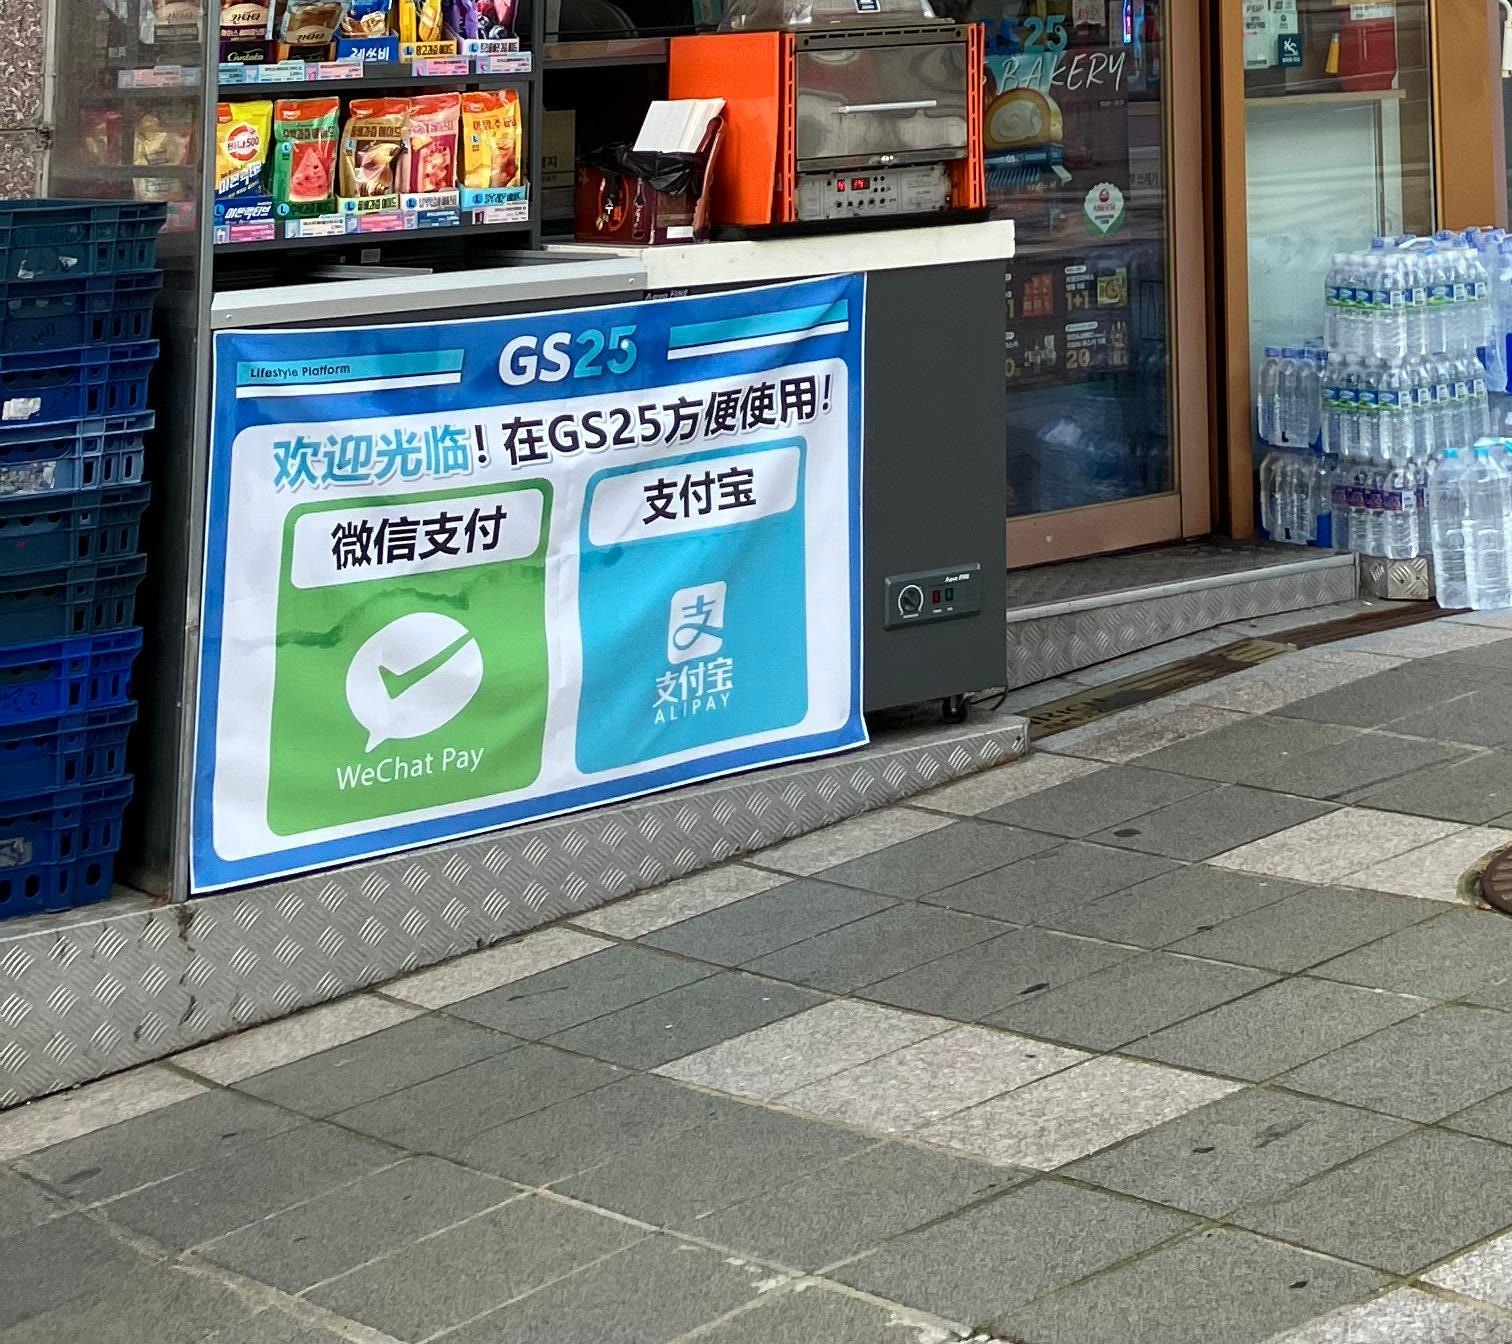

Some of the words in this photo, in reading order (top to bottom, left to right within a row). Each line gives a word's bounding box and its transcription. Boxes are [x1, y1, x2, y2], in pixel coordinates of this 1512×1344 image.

[349, 46, 390, 62] 레쓰비
[996, 51, 1126, 96] BAKERY
[249, 365, 299, 379] Lifestyle
[301, 363, 351, 377] Platform
[498, 324, 638, 386] GS25
[641, 465, 758, 526] 支付宝
[330, 504, 507, 570] 微信支付
[652, 657, 734, 708] 支付宝
[654, 693, 731, 725] ALIPAY
[336, 755, 437, 792] WeChat
[440, 745, 485, 775] Pay
